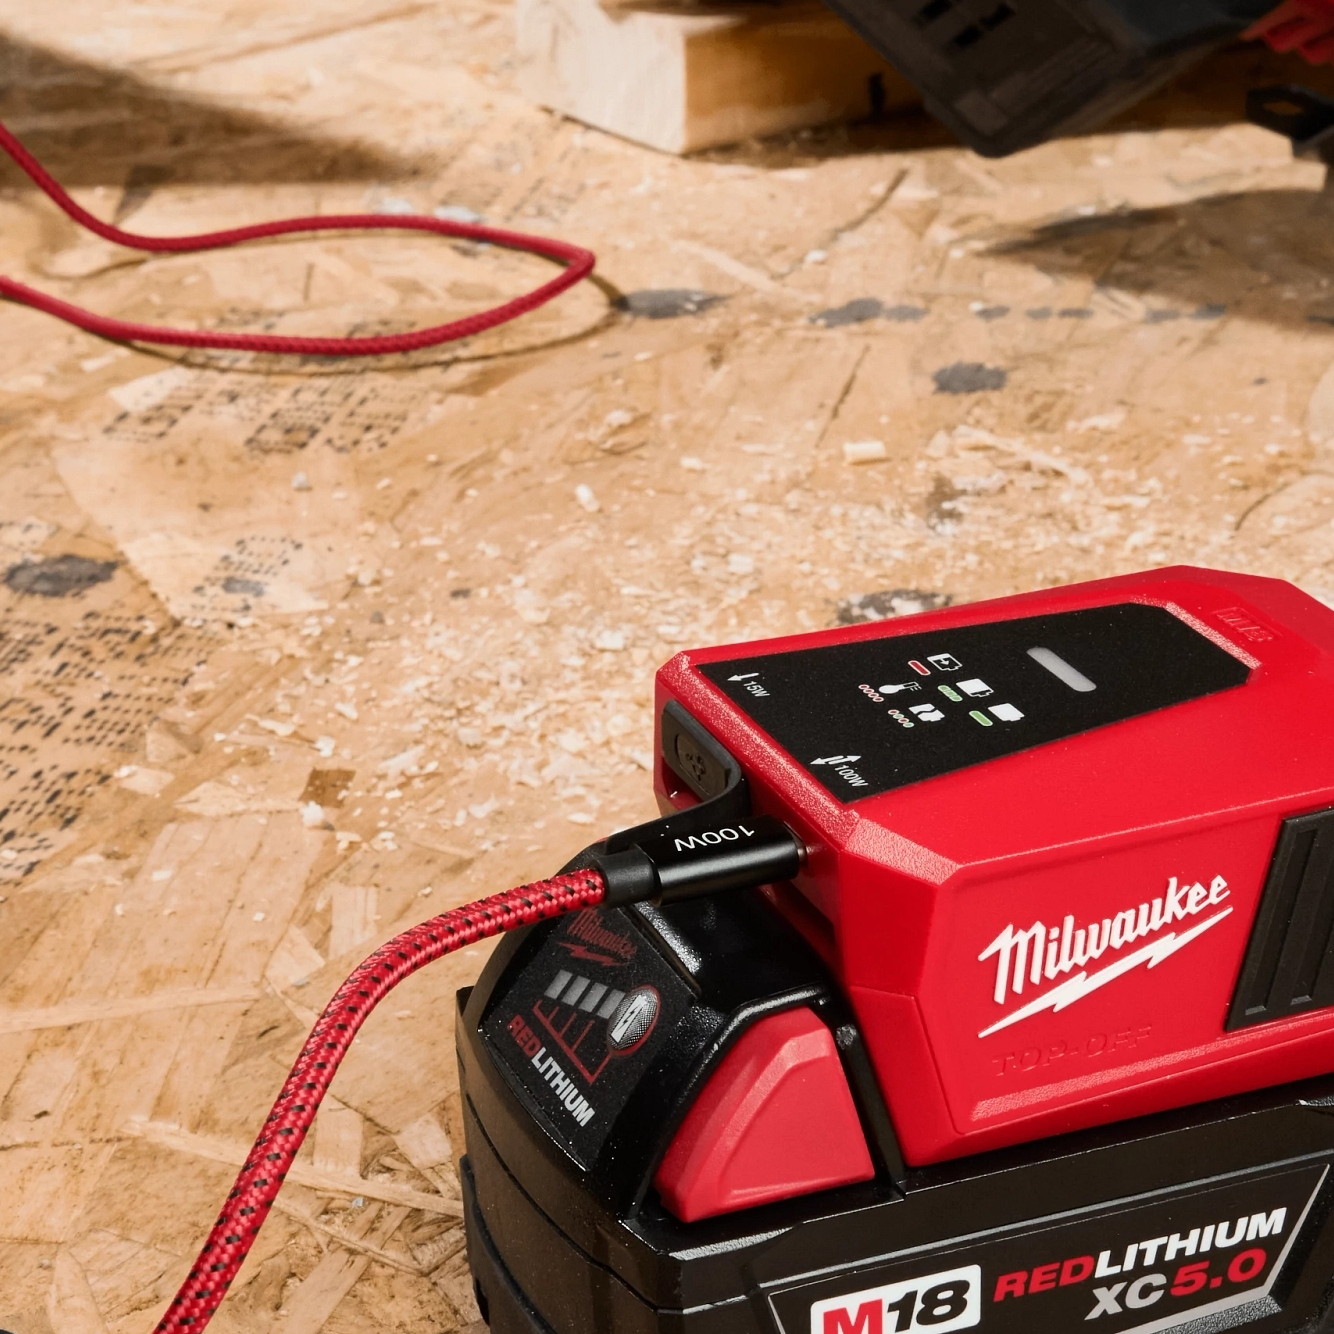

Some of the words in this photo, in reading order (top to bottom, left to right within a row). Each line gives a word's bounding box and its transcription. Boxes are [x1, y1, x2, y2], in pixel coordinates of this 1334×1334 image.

[742, 680, 771, 698] 15W
[835, 760, 869, 788] 100W
[674, 825, 756, 852] 100W
[977, 874, 1231, 1005] Milwaukee
[506, 1014, 597, 1128] REDLITHIUM
[992, 1023, 1153, 1077] TOP-OFF
[992, 1207, 1288, 1303] REDLITHIUM
